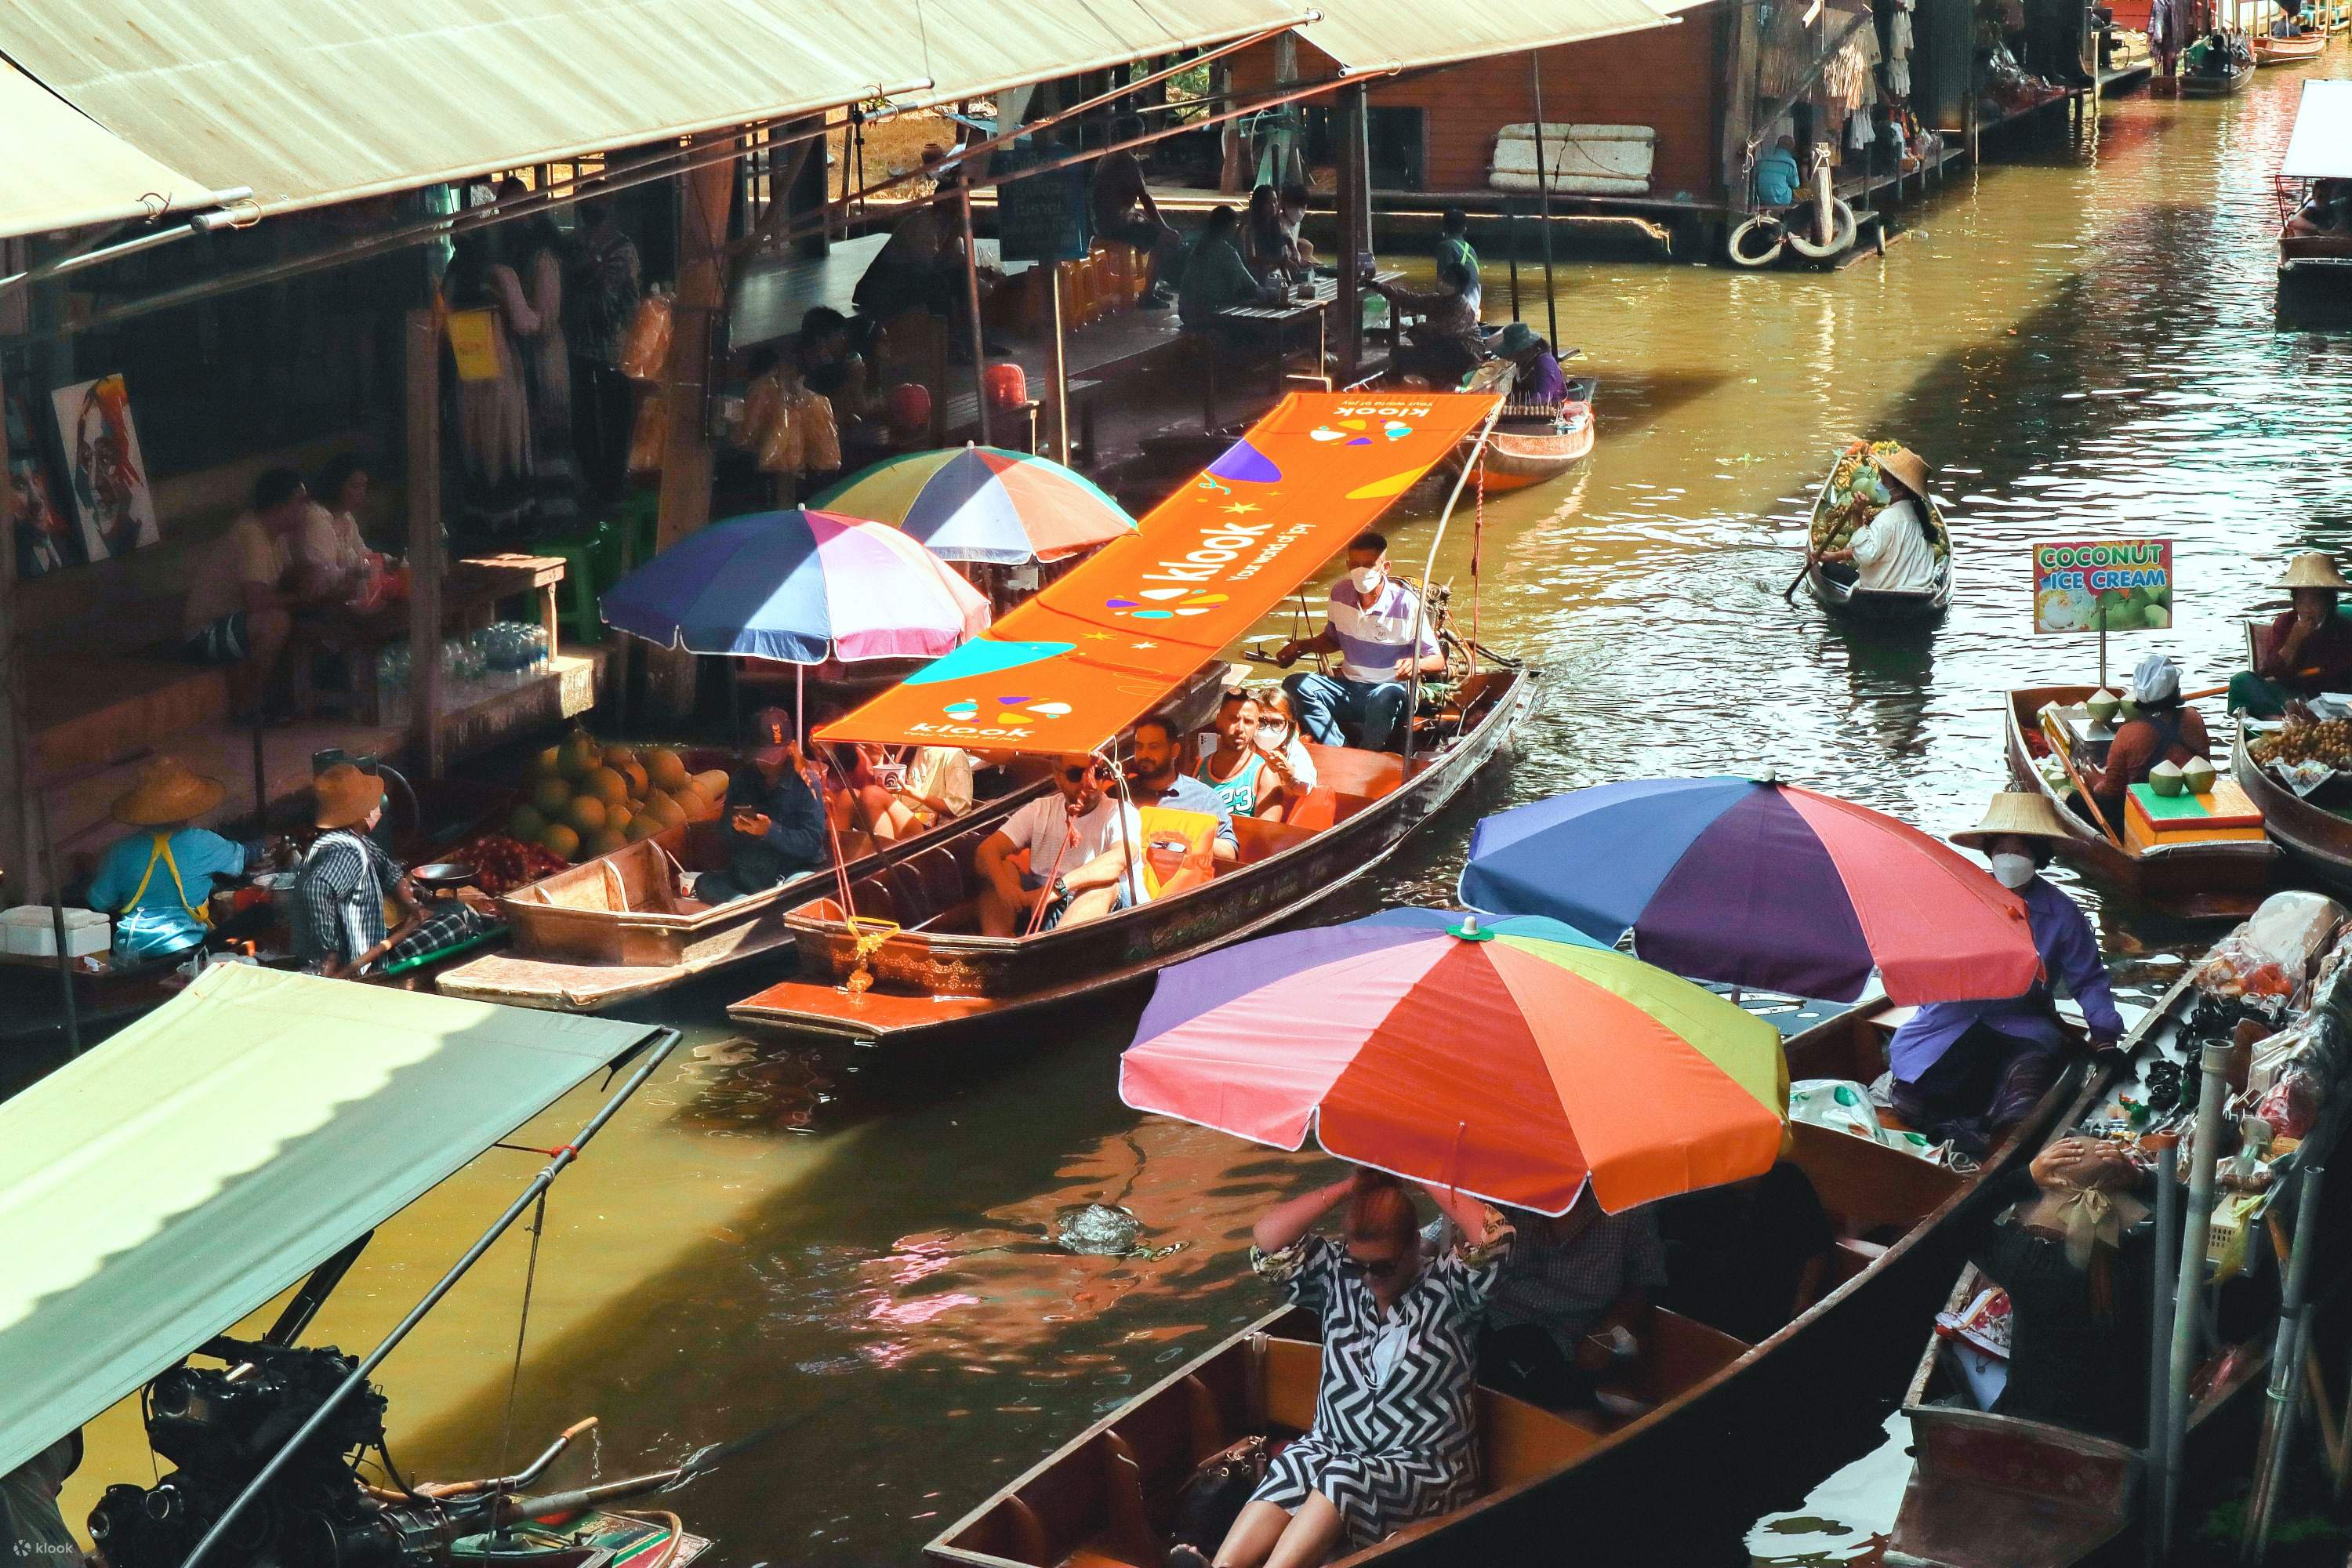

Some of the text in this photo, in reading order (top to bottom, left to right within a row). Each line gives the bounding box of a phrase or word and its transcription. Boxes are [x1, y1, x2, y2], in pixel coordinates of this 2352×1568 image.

[1333, 407, 1431, 417] klook
[1142, 522, 1275, 582] klook
[1225, 523, 1317, 582] Your world of joy
[2039, 544, 2164, 568] COCONUT
[2050, 568, 2167, 590] ICE CREAM
[909, 722, 1036, 738] klook
[1219, 785, 1254, 814] 23
